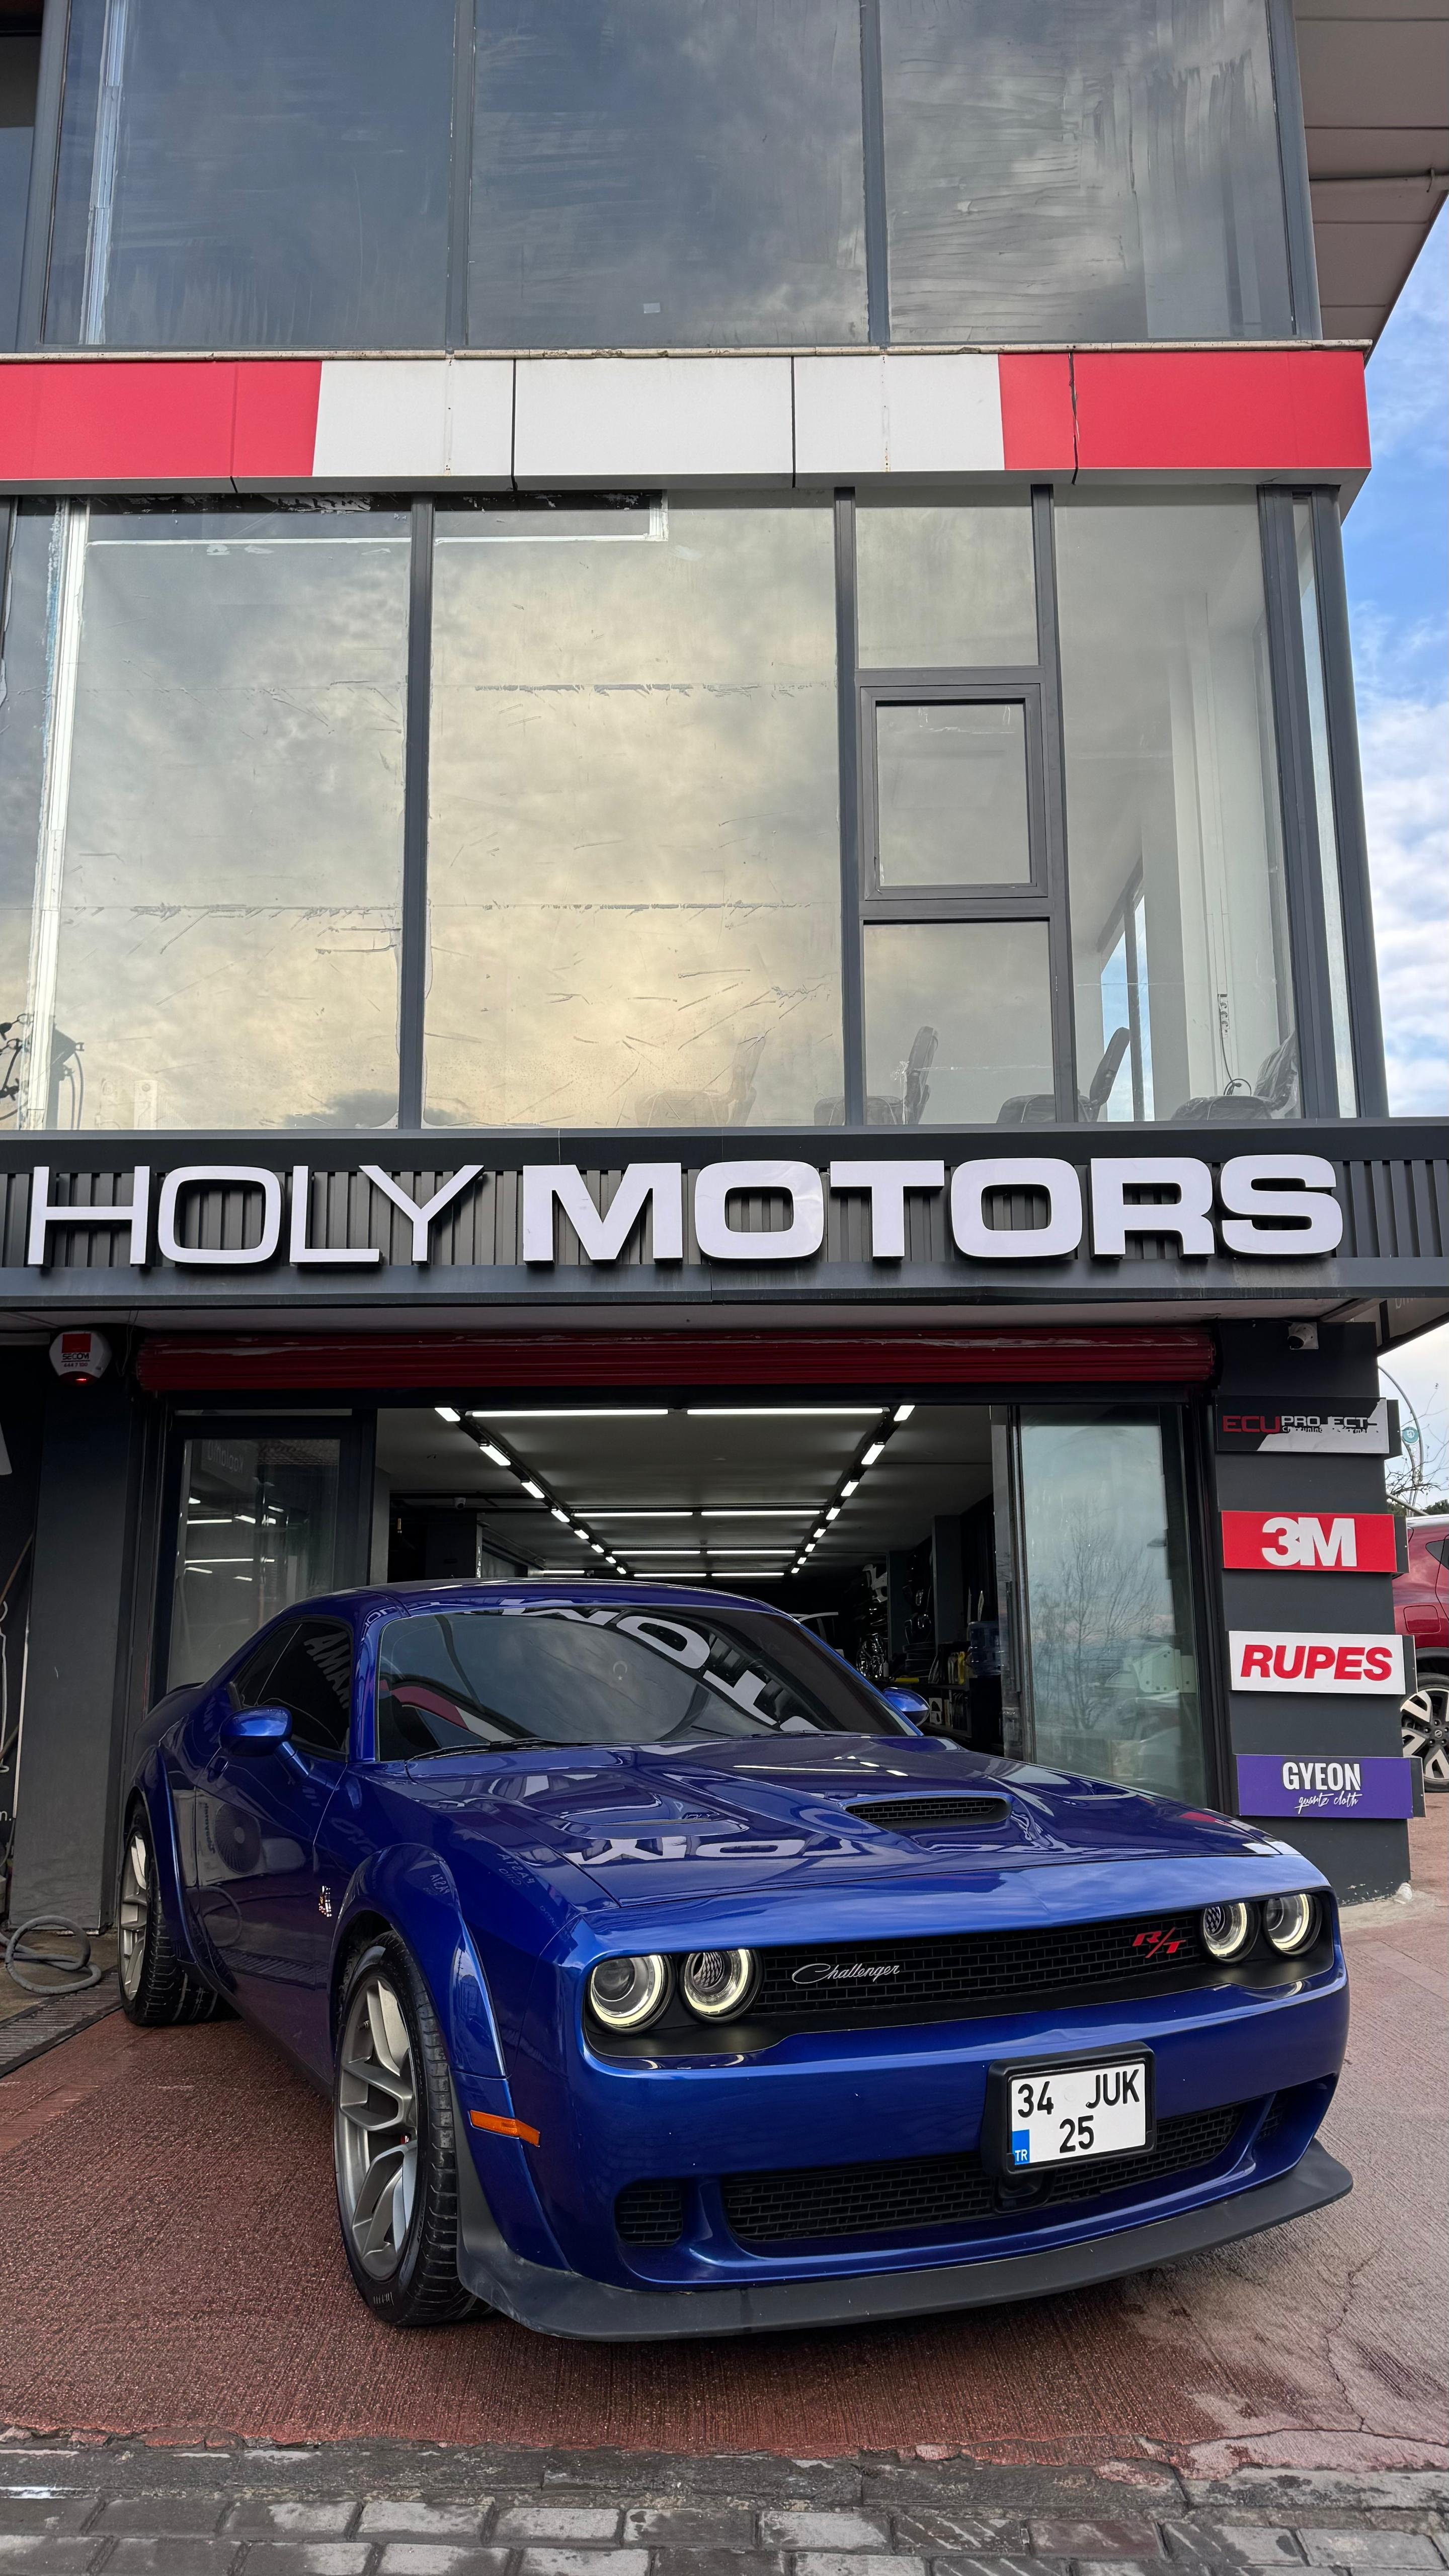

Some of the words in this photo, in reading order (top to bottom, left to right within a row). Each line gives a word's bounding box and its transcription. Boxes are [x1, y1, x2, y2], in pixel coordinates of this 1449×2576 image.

[28, 1165, 484, 1264] HOLY
[523, 1155, 1342, 1261] MOTORS
[1262, 1517, 1357, 1567] 3M
[1241, 1644, 1392, 1681] RUPES
[1283, 1762, 1361, 1791] GYEON
[1133, 1926, 1186, 1958] R/T
[792, 1963, 900, 1984] Challenger
[1018, 2081, 1054, 2118] 34
[1086, 2069, 1140, 2109] JUK
[1060, 2115, 1094, 2153] 25
[1014, 2149, 1027, 2162] TR
